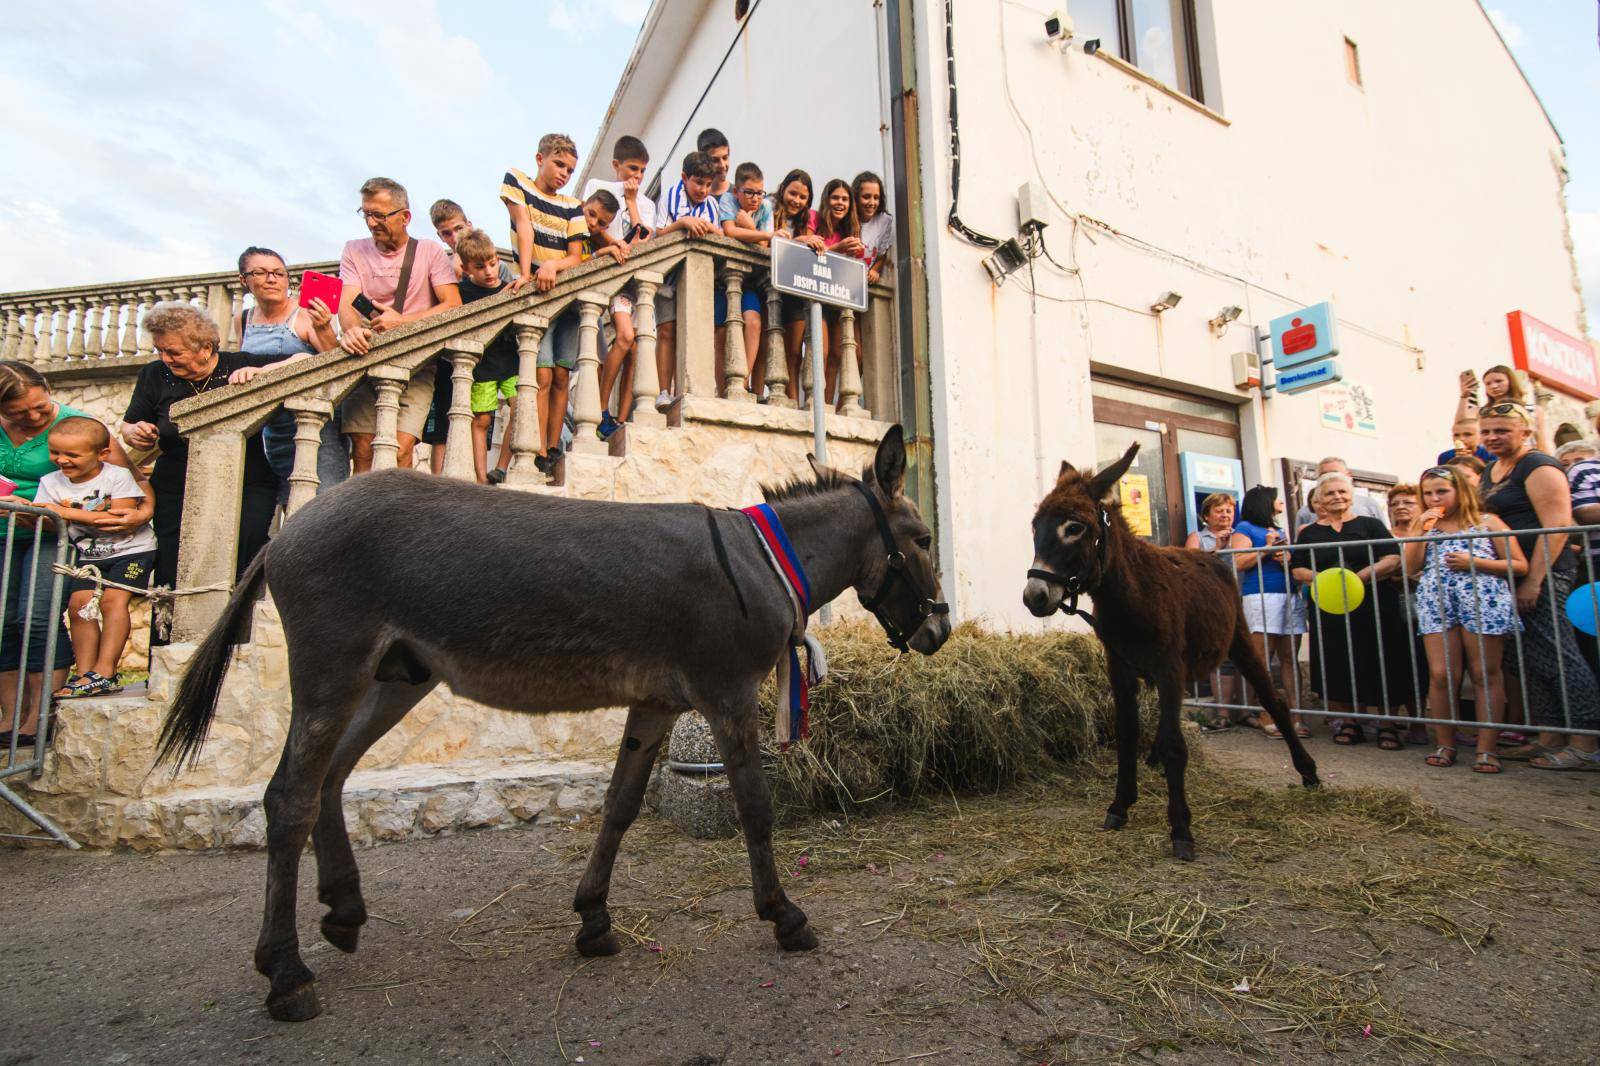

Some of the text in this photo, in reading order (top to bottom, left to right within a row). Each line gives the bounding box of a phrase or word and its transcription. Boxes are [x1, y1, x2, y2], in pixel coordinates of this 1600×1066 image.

[813, 264, 832, 279] BANA
[793, 274, 817, 291] JOSIPA
[1280, 367, 1327, 385] Bankomat
